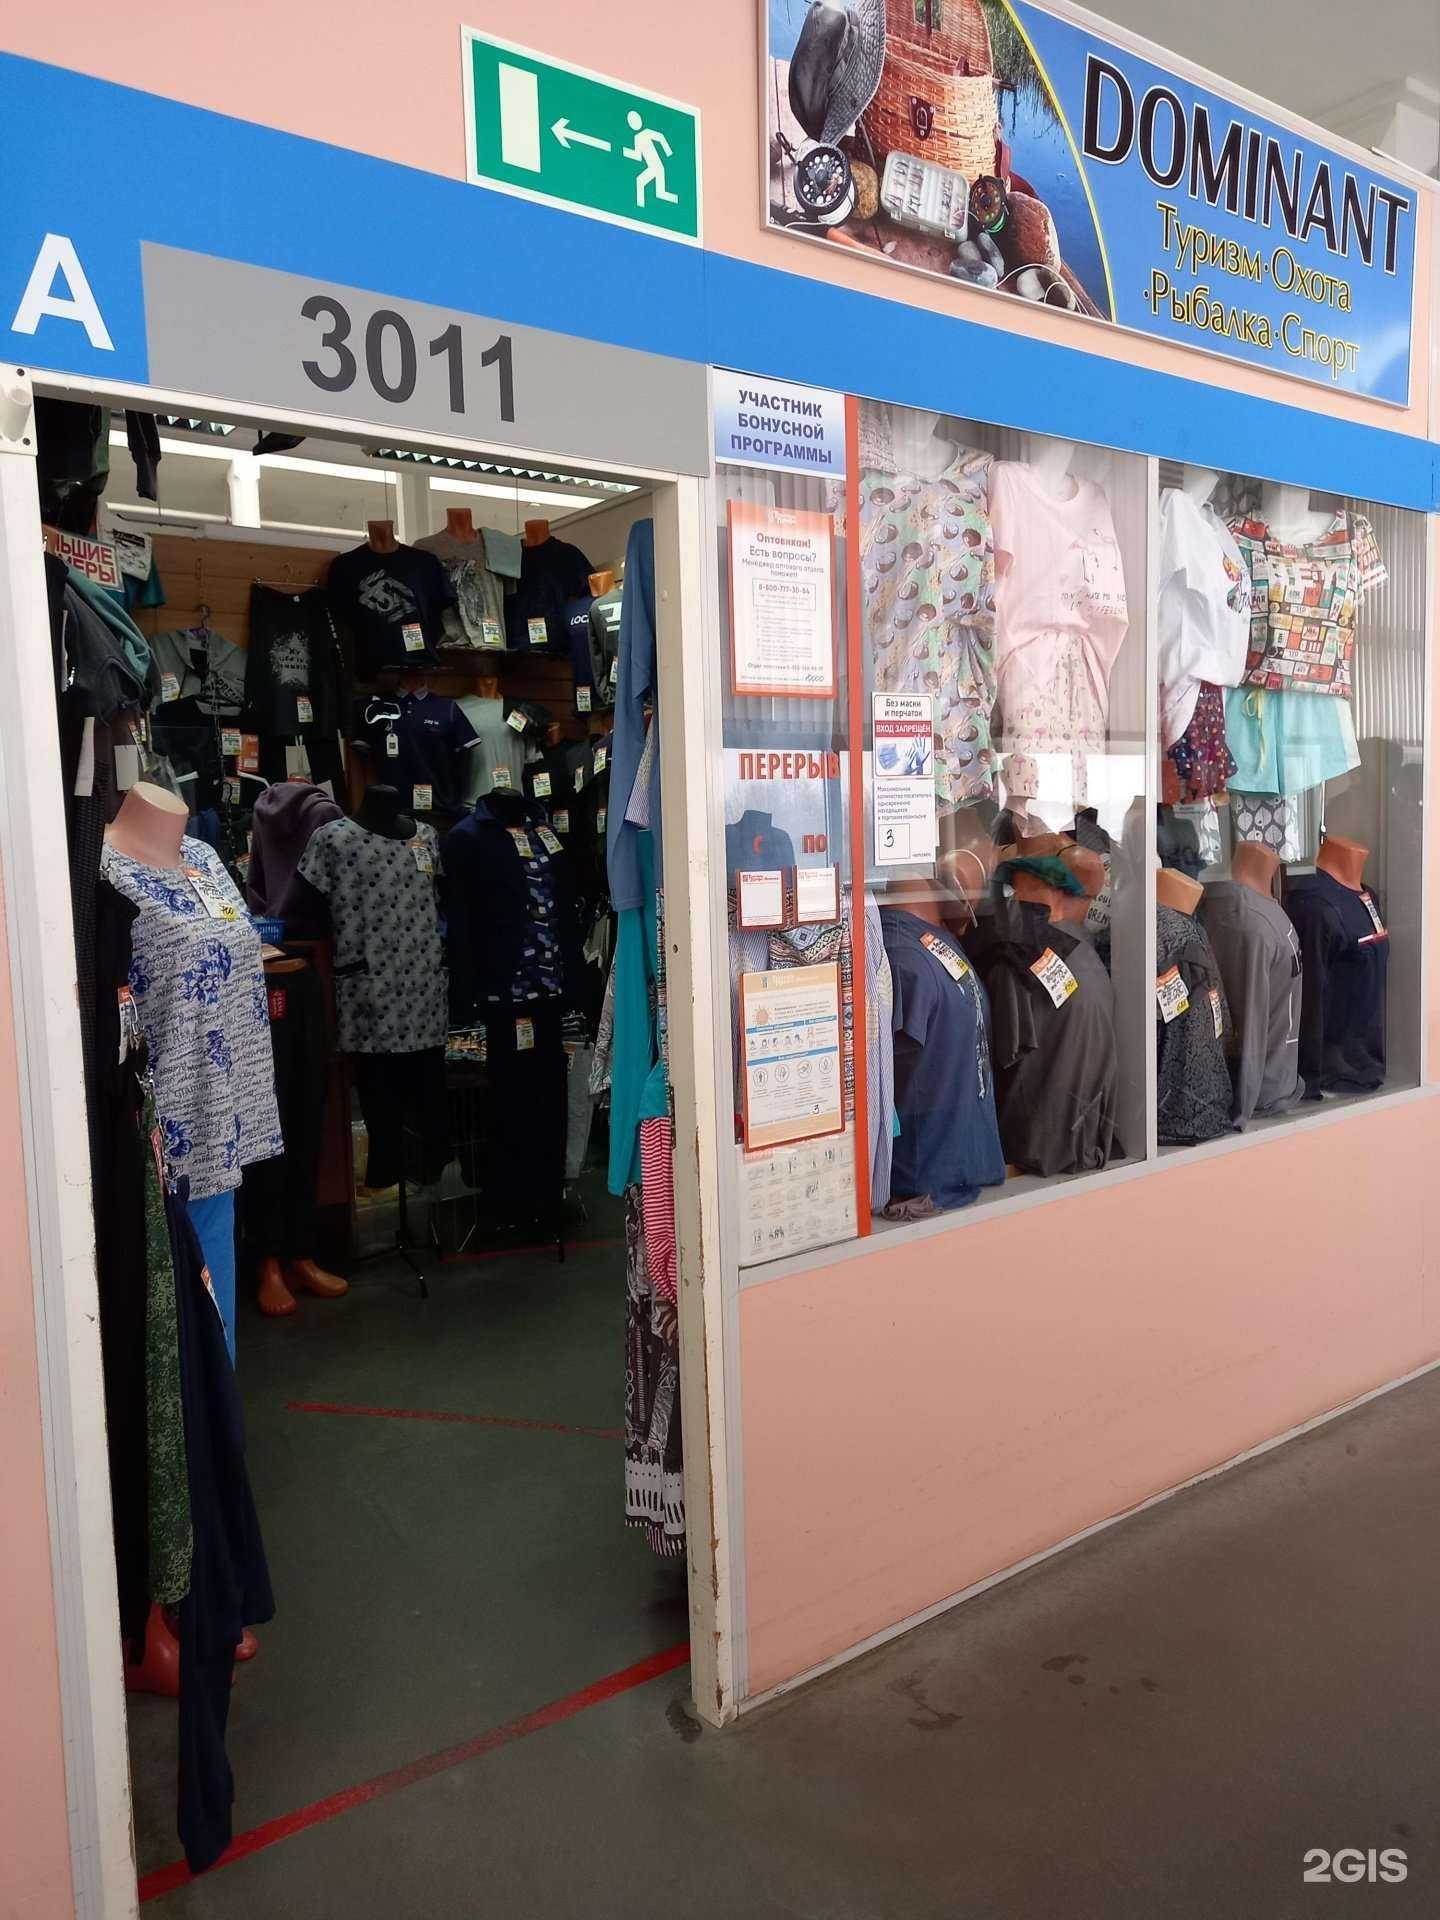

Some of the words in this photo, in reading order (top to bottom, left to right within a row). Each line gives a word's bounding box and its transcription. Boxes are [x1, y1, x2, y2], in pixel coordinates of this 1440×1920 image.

[1083, 52, 1409, 275] DOMINANT
[300, 296, 515, 423] 3011
[739, 389, 822, 418] УЧАСТНИК
[738, 412, 824, 440] БОНУСНОЙ
[731, 434, 832, 464] ПРОГРАММЫ
[750, 545, 770, 558] Есть
[772, 550, 817, 563] вопросы?
[885, 698, 898, 708] Без
[900, 699, 922, 708] маски
[891, 709, 922, 719] перчаток
[876, 724, 894, 734] ВХОД
[738, 752, 840, 779] ПЕРЕРЫВ
[883, 828, 895, 848] 3
